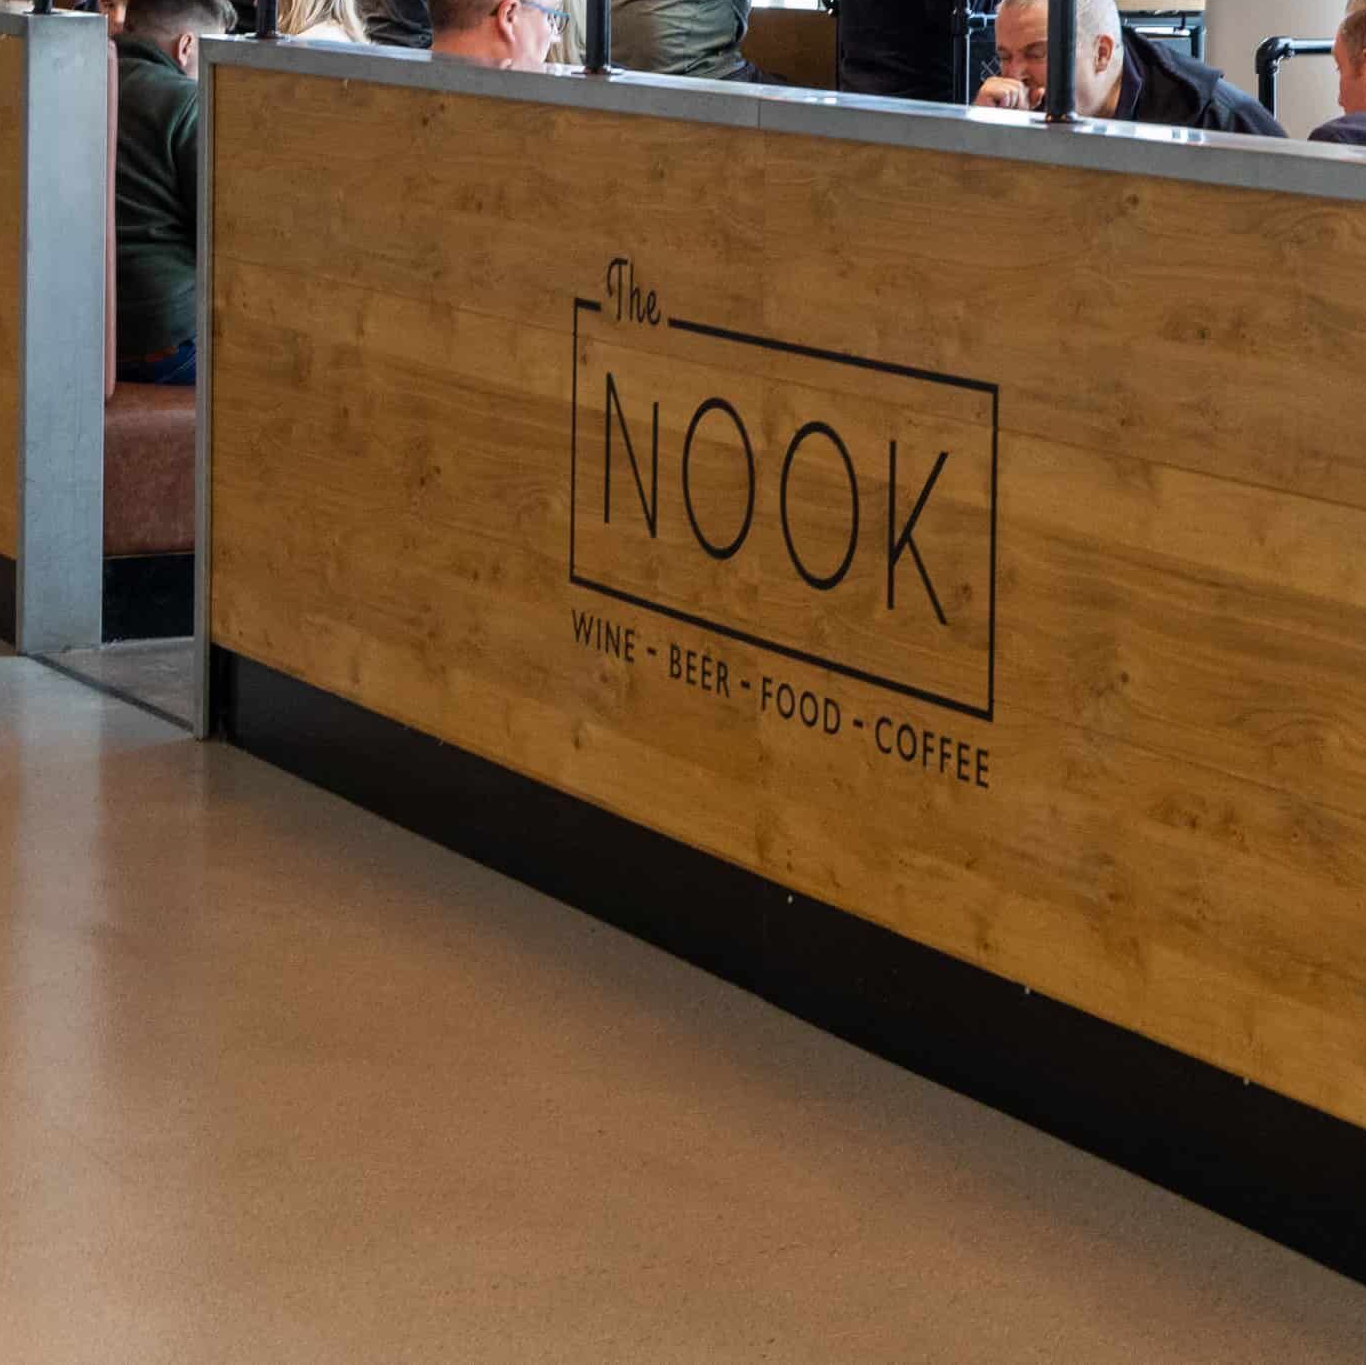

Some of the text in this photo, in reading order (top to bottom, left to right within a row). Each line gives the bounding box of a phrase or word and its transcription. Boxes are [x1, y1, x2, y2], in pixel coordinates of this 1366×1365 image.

[606, 257, 662, 326] The
[602, 370, 950, 626] NOOK
[571, 609, 635, 663] WINE
[668, 644, 731, 698] BEER
[761, 676, 841, 735] FOOD
[874, 715, 991, 789] COFFEE
